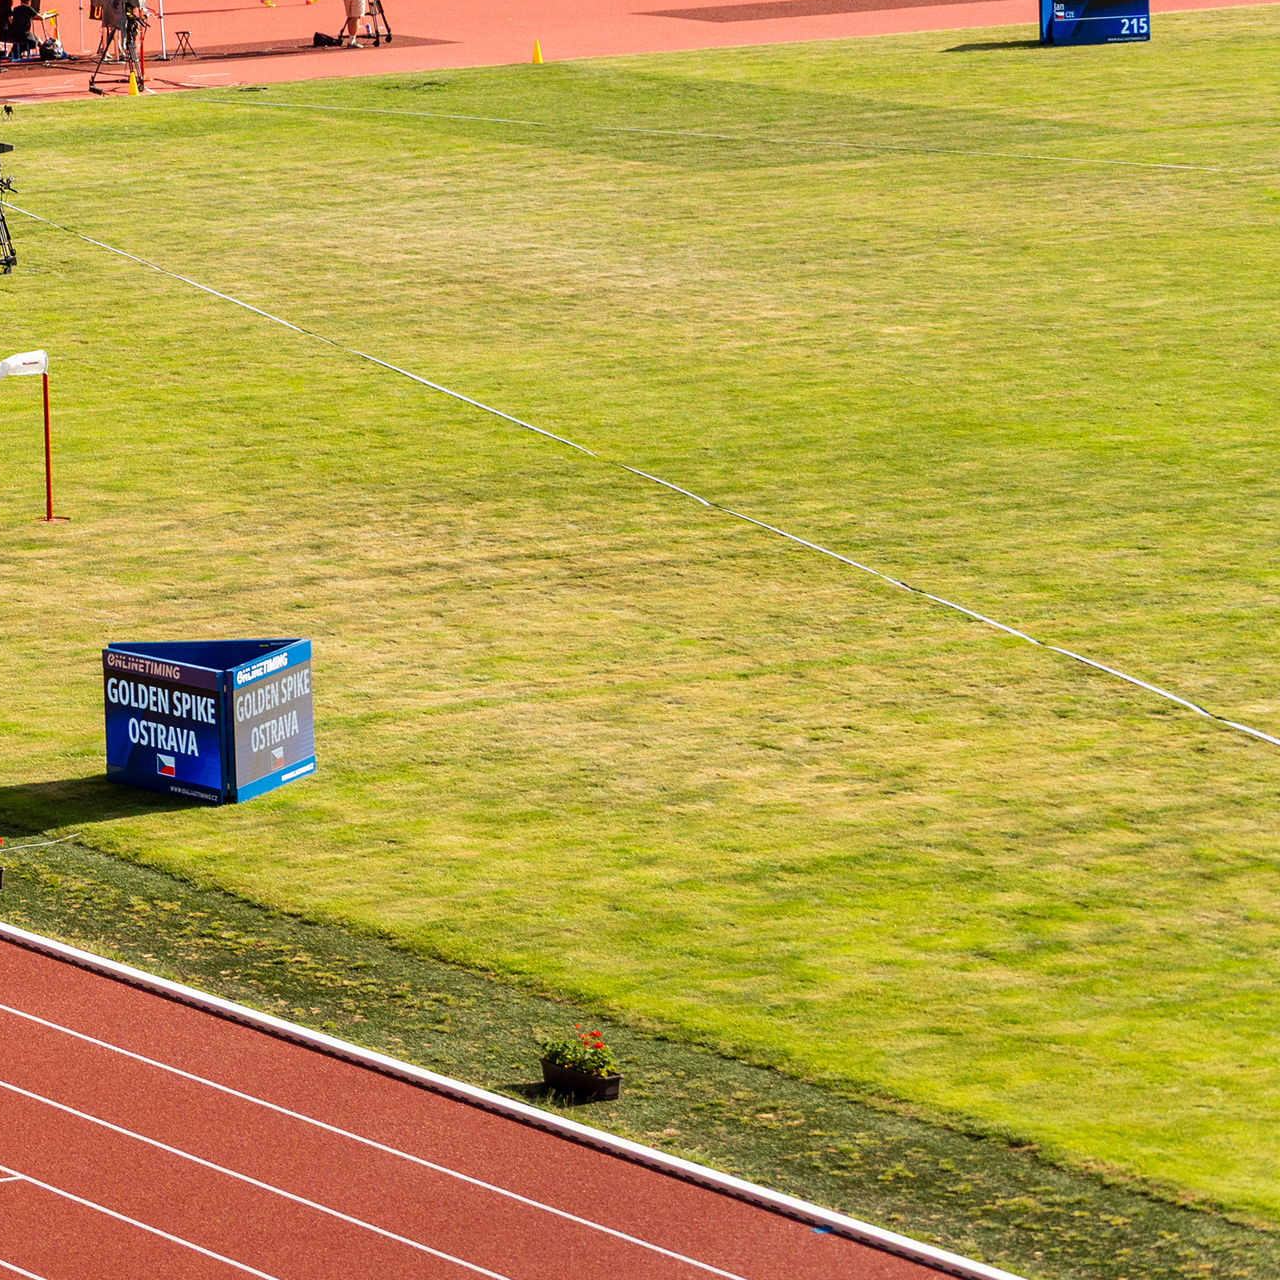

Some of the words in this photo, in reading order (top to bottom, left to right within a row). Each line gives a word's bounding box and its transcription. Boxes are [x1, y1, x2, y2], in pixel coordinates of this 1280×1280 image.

[1053, 2, 1065, 12] Jan
[1120, 18, 1148, 35] 215
[107, 653, 181, 680] ONLINETIMING
[237, 652, 288, 685] ONLINETIMING
[107, 677, 170, 715] GOLDEN
[172, 691, 216, 725] SPIKE
[236, 686, 279, 722] GOLDEN
[281, 668, 310, 703] SPIKE
[128, 717, 199, 757] OSTRAVA
[251, 710, 299, 753] OSTRAVA
